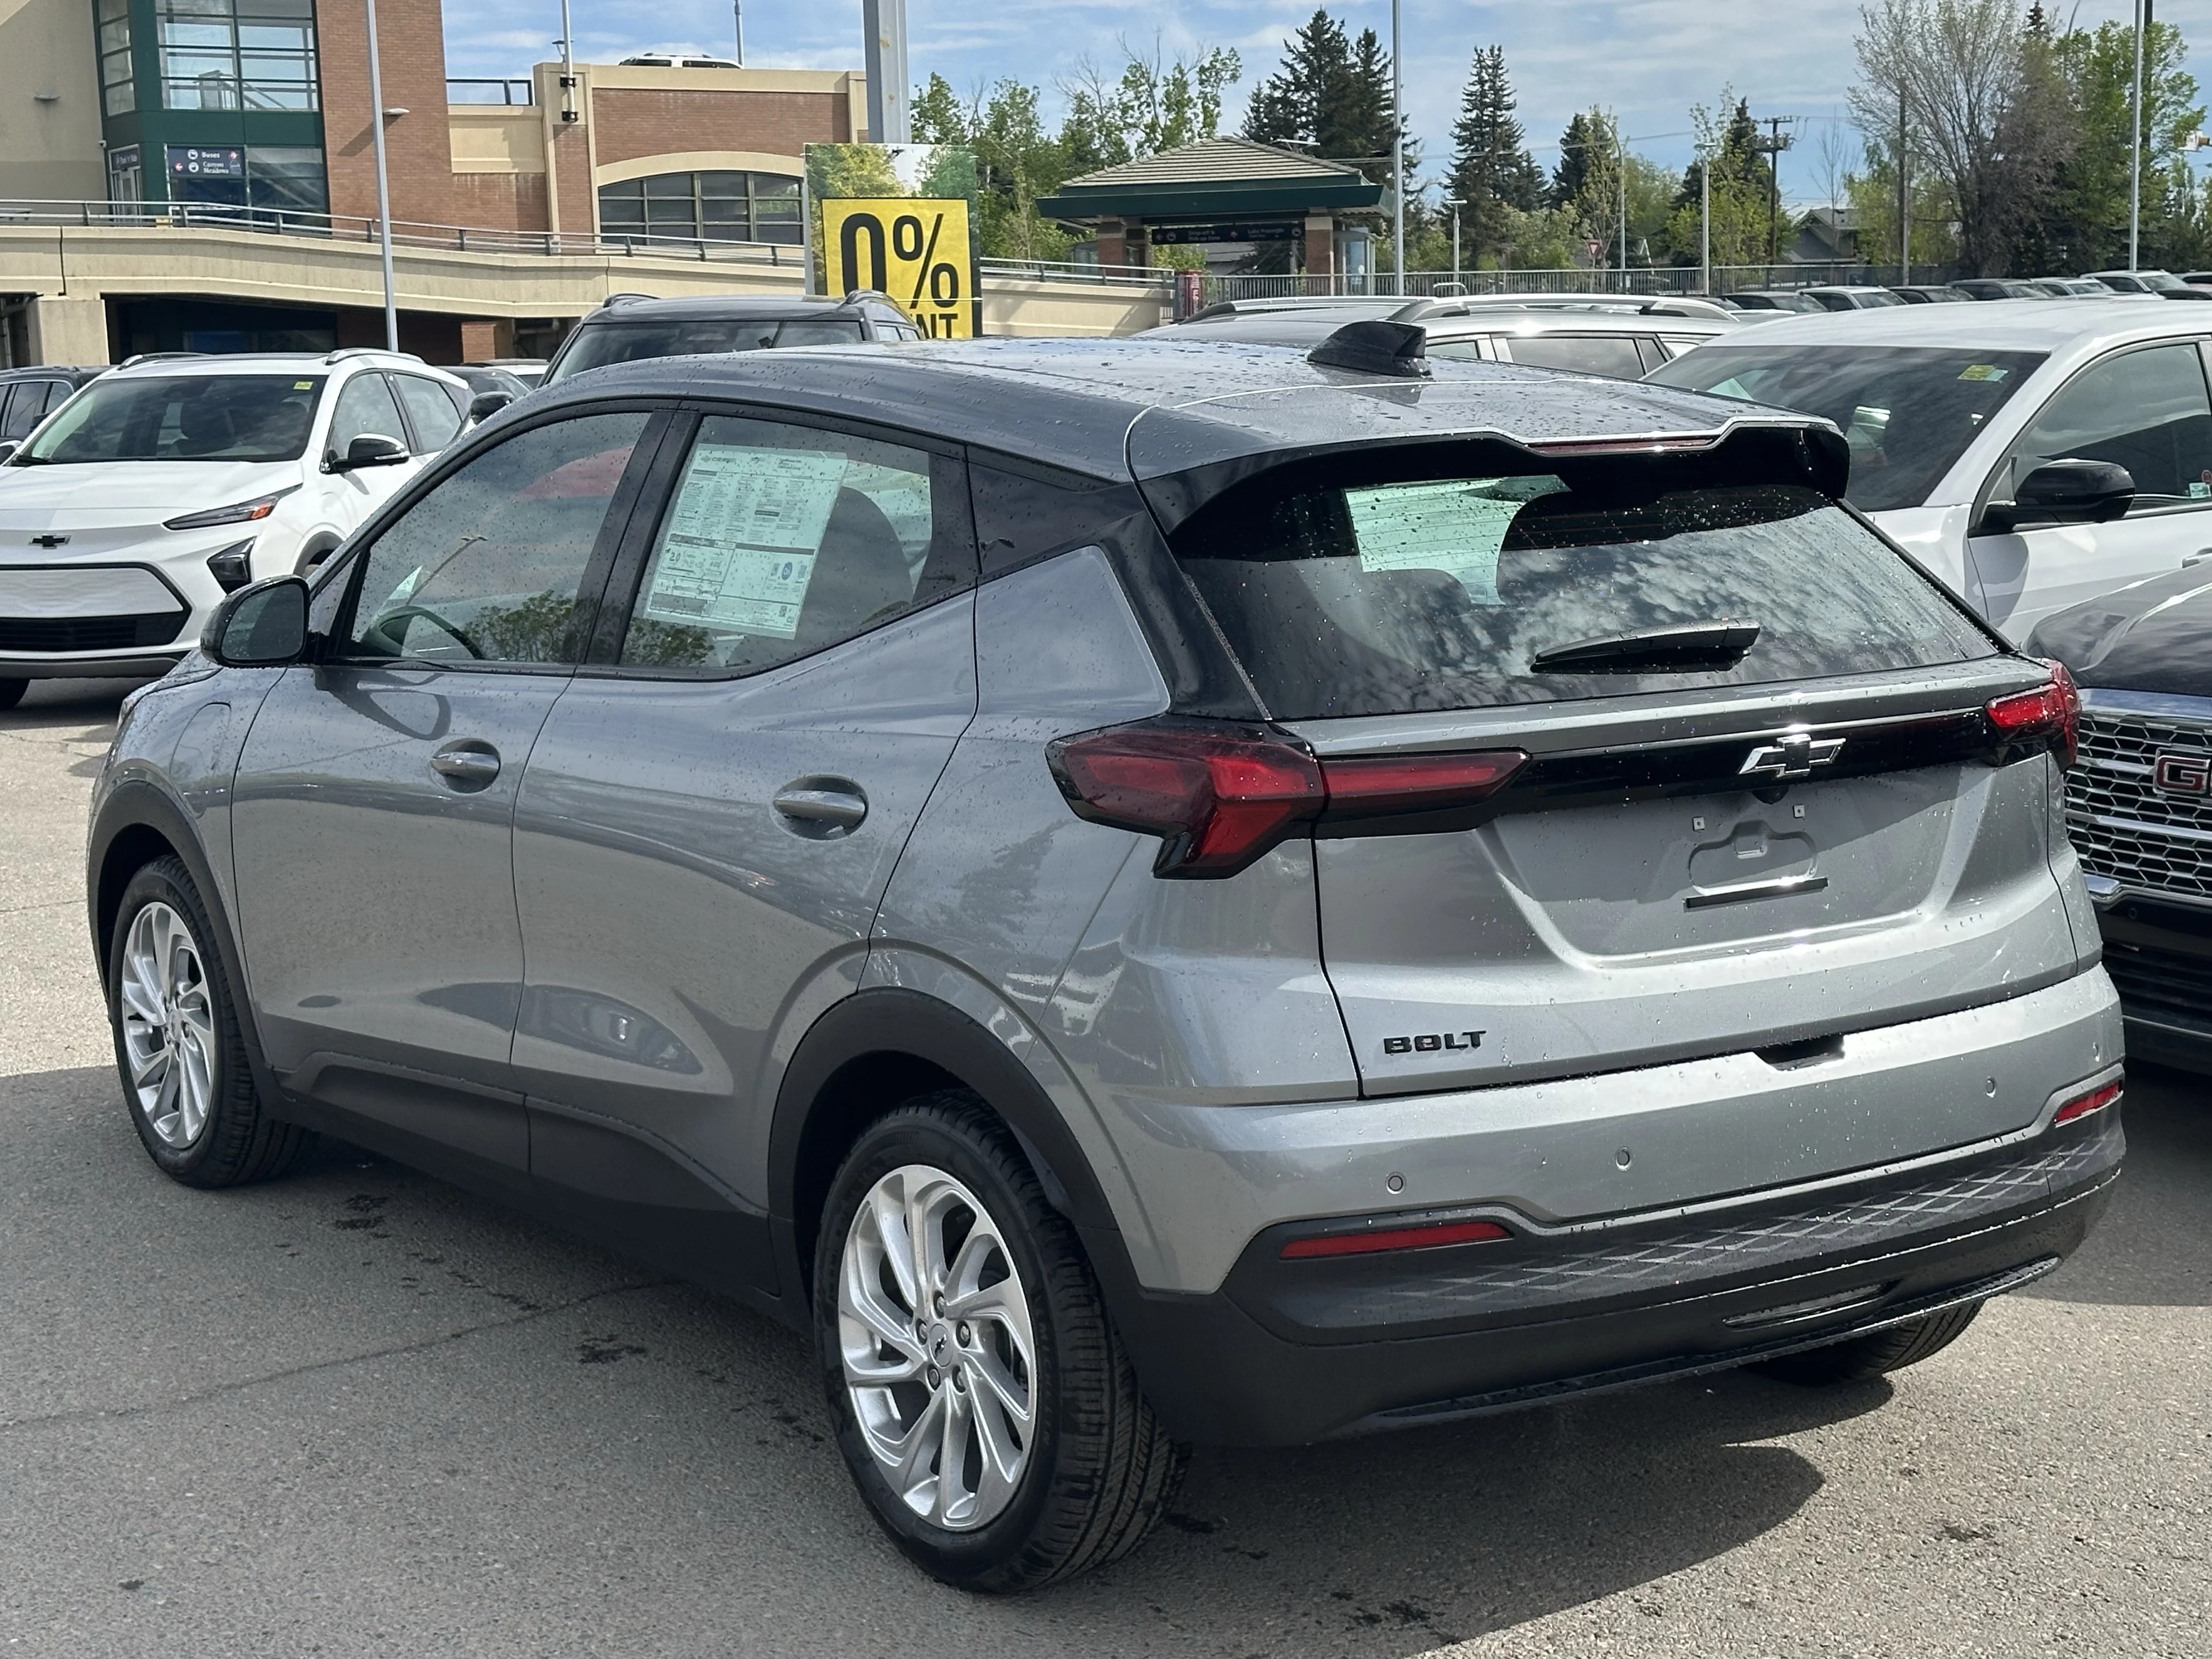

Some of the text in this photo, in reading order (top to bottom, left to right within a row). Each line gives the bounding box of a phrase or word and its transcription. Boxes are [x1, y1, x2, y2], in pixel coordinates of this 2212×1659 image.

[840, 212, 959, 309] 0%
[910, 313, 958, 339] NT
[2156, 755, 2212, 795] G
[1383, 1030, 1487, 1054] BOLT
[1037, 1322, 1053, 1445] MICHELIN
